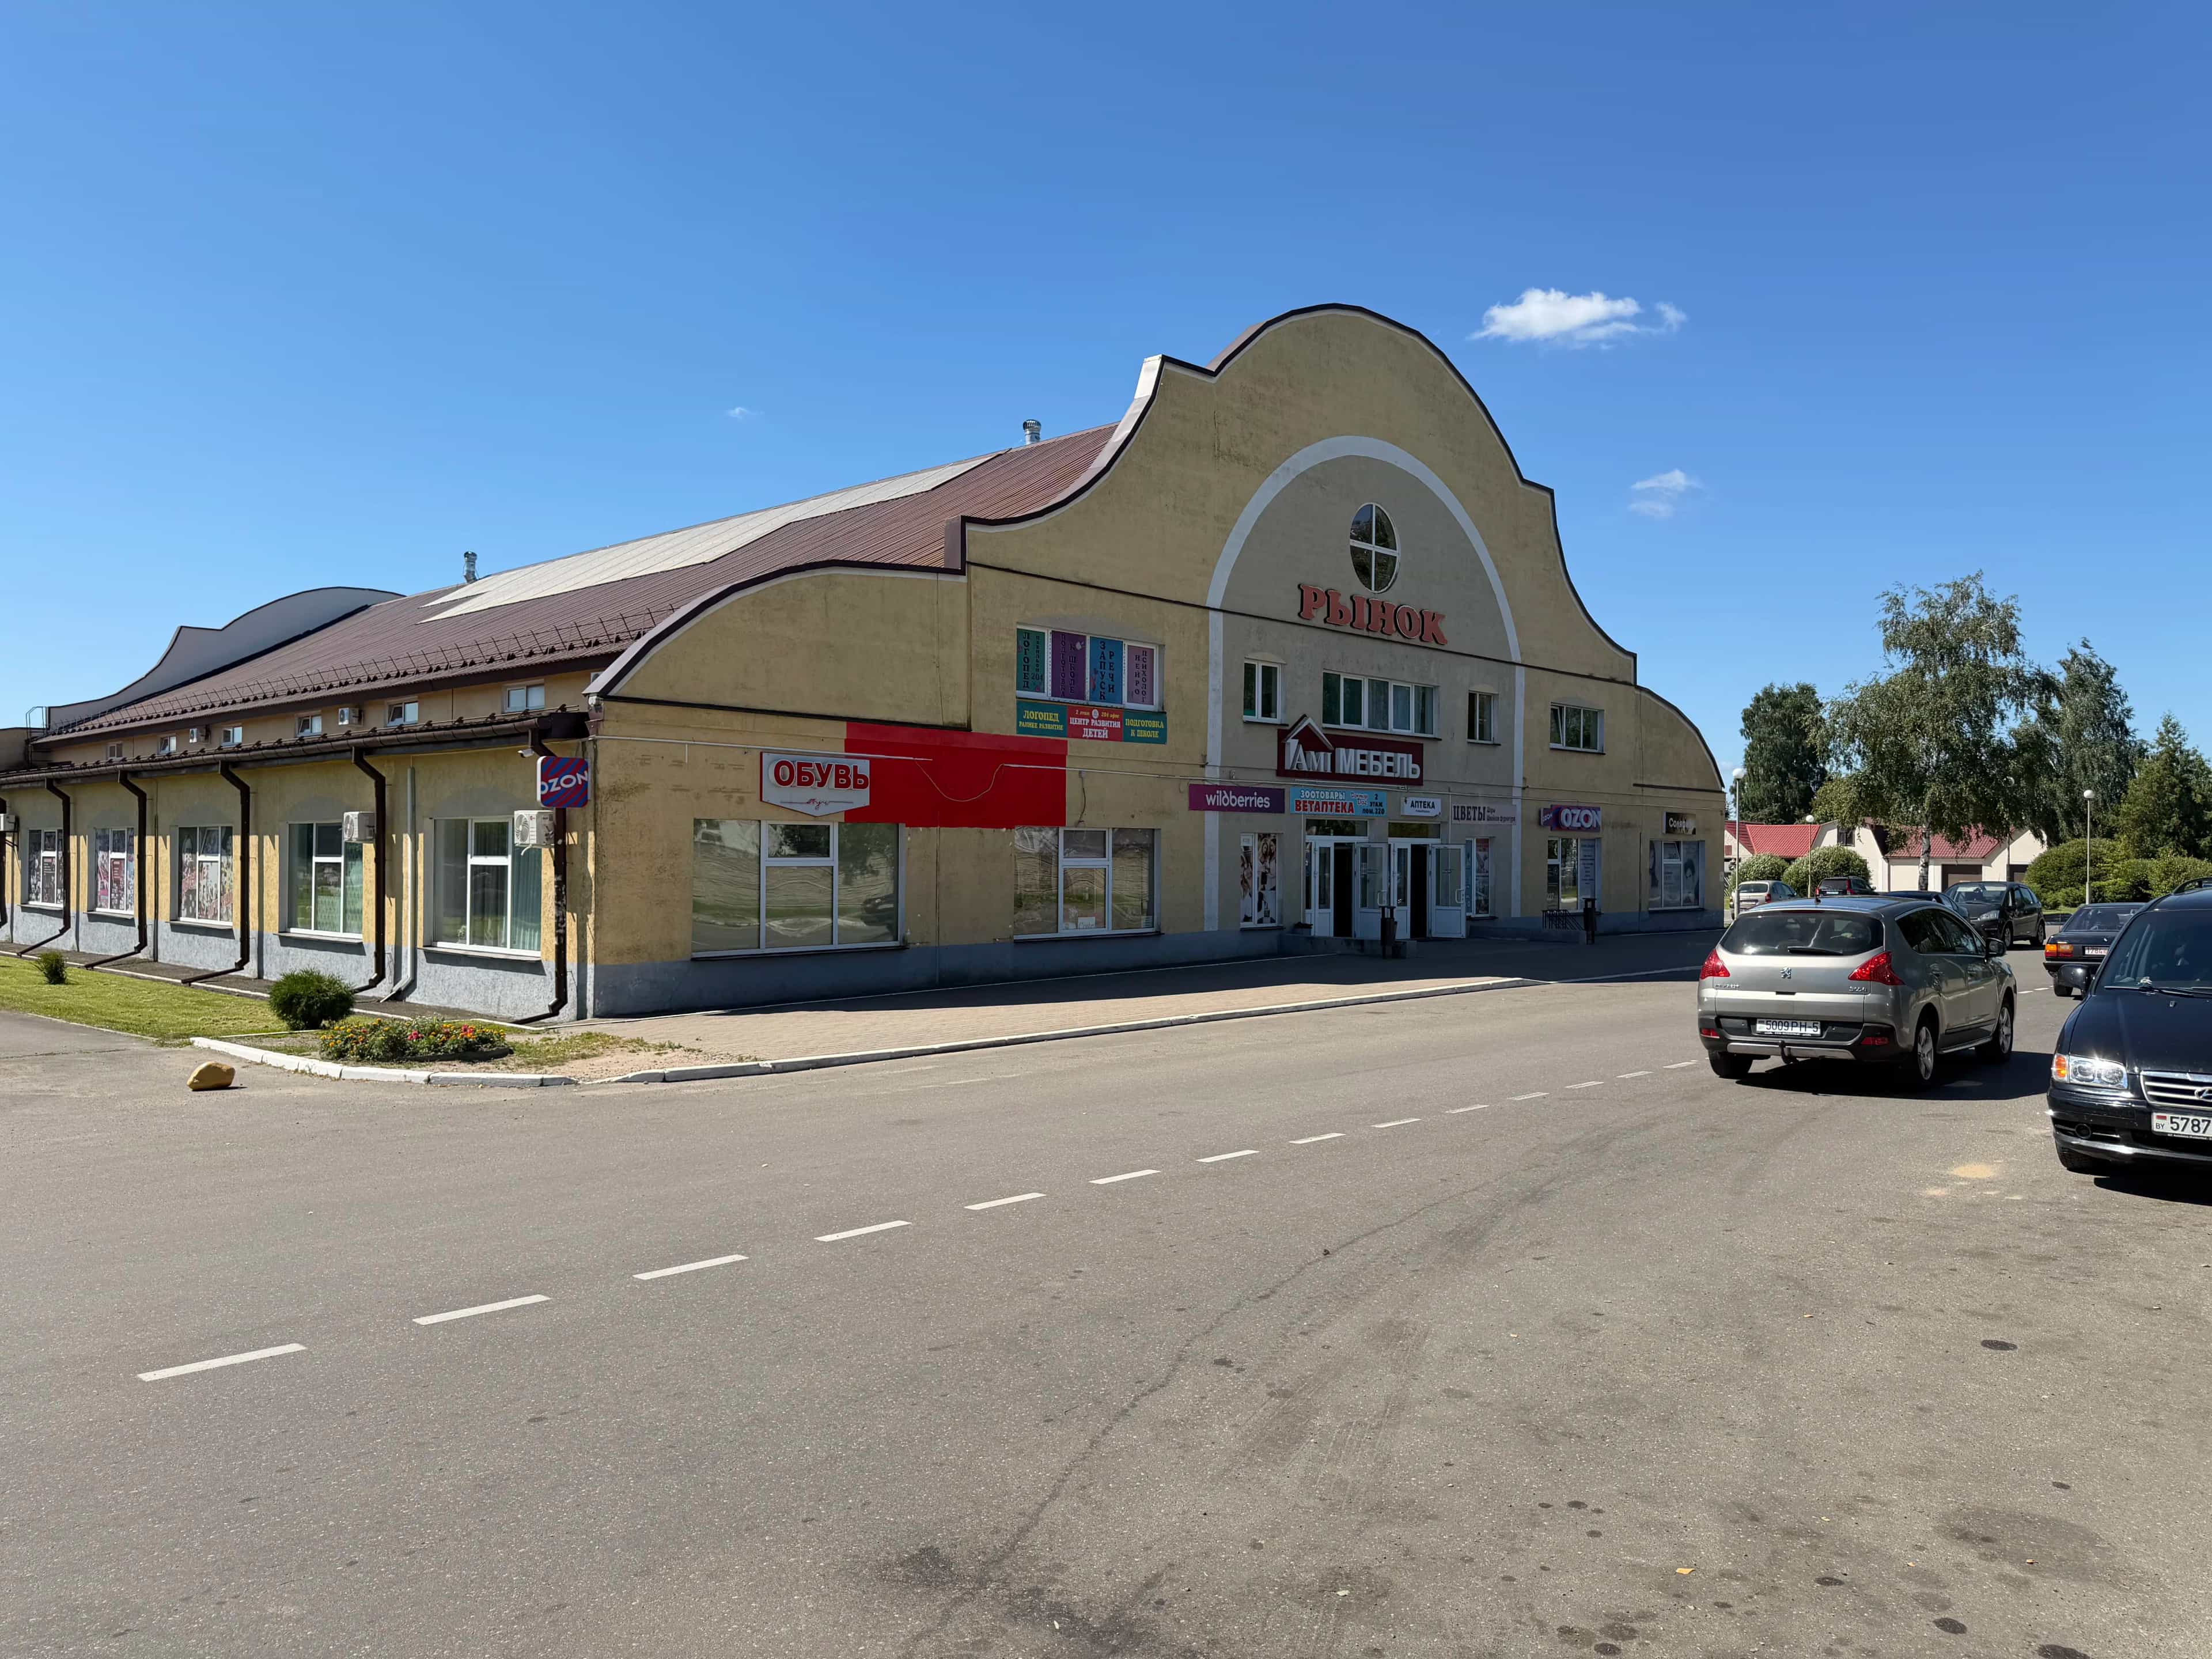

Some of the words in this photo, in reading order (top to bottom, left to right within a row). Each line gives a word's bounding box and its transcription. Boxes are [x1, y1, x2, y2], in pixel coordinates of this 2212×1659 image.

[1298, 584, 1448, 645] РЫНОК
[1023, 710, 1059, 722] ЛОГОПЕД
[1069, 717, 1089, 726] ЦЕНТР
[1091, 720, 1121, 728] РАЗВИТИЯ
[1125, 718, 1164, 729] ПОДГОТОВКА
[1082, 728, 1108, 738] ДЕТЕЙ
[1131, 729, 1136, 737] К
[1137, 730, 1159, 738] ШКОЛЕ
[1335, 747, 1421, 779] МЕБЕЛЬ
[540, 770, 589, 795] OZON
[772, 760, 870, 790] ОБУВЬ
[1206, 790, 1271, 808] wildberries
[1300, 790, 1346, 800] ЗООТОВАРЫ
[1294, 799, 1355, 813] ВЕТАПТЕКА
[1410, 800, 1435, 809] АПТЕКА
[1453, 805, 1486, 821] ЦВЕТЫ
[1560, 808, 1600, 828] OZON
[2170, 1116, 2211, 1134] 5787
